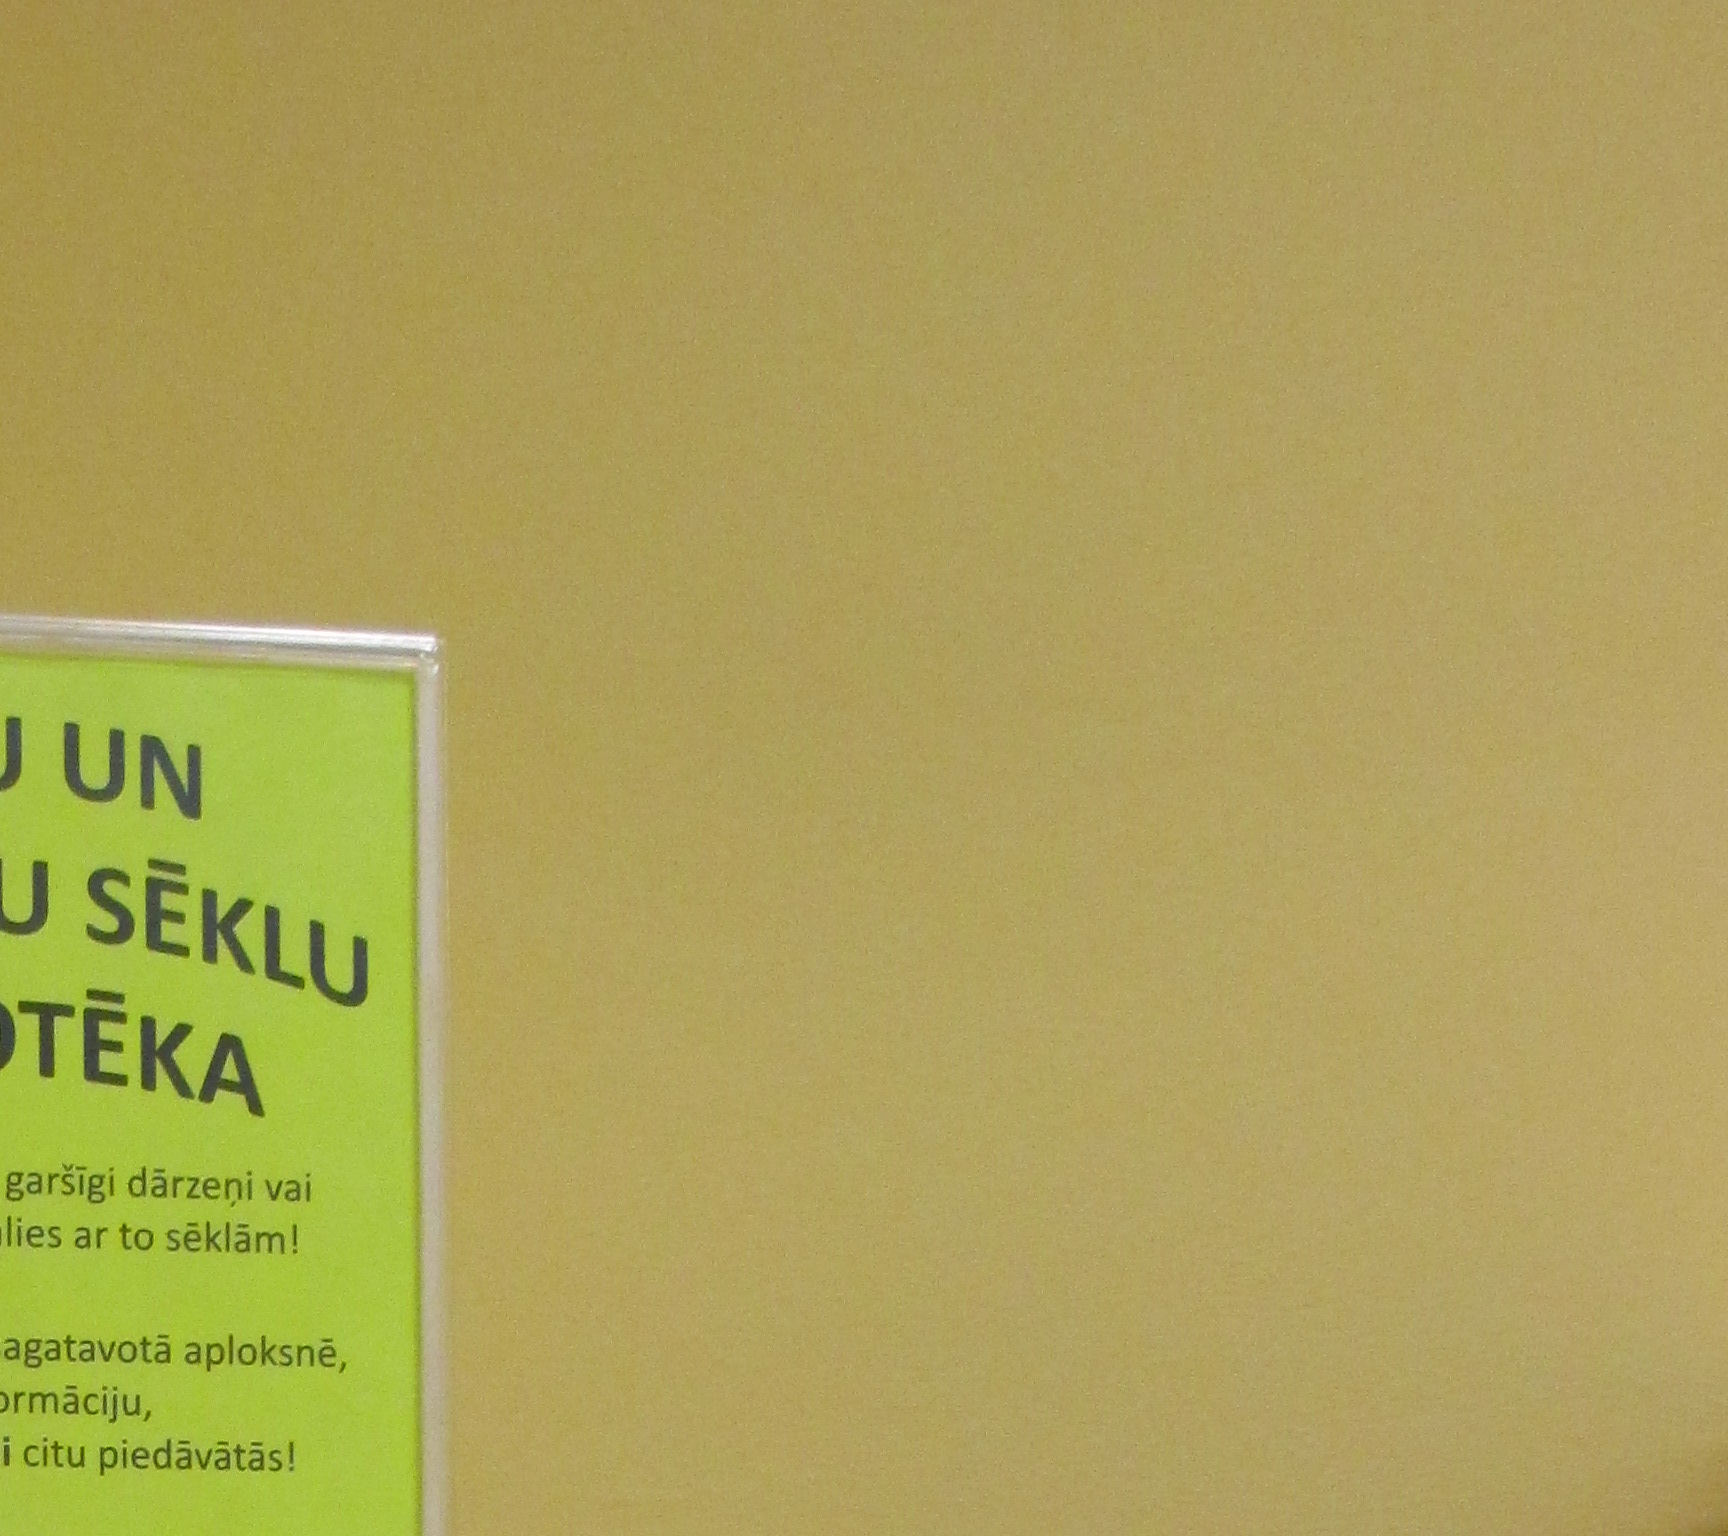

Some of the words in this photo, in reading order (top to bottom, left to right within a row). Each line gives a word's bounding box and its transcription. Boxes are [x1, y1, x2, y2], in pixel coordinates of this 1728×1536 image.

[63, 721, 202, 821] UN
[85, 857, 369, 1008] SĒKLU
[5, 1163, 115, 1205] garšīgi
[127, 1165, 253, 1208] dārzeņi
[264, 1172, 312, 1203] vai
[74, 1226, 109, 1250] ar
[118, 1222, 154, 1252] to
[166, 1220, 298, 1255] sēklām!
[184, 1333, 347, 1374] aploksnē,
[23, 1437, 86, 1469] citu
[99, 1438, 295, 1477] piedāvātās!
